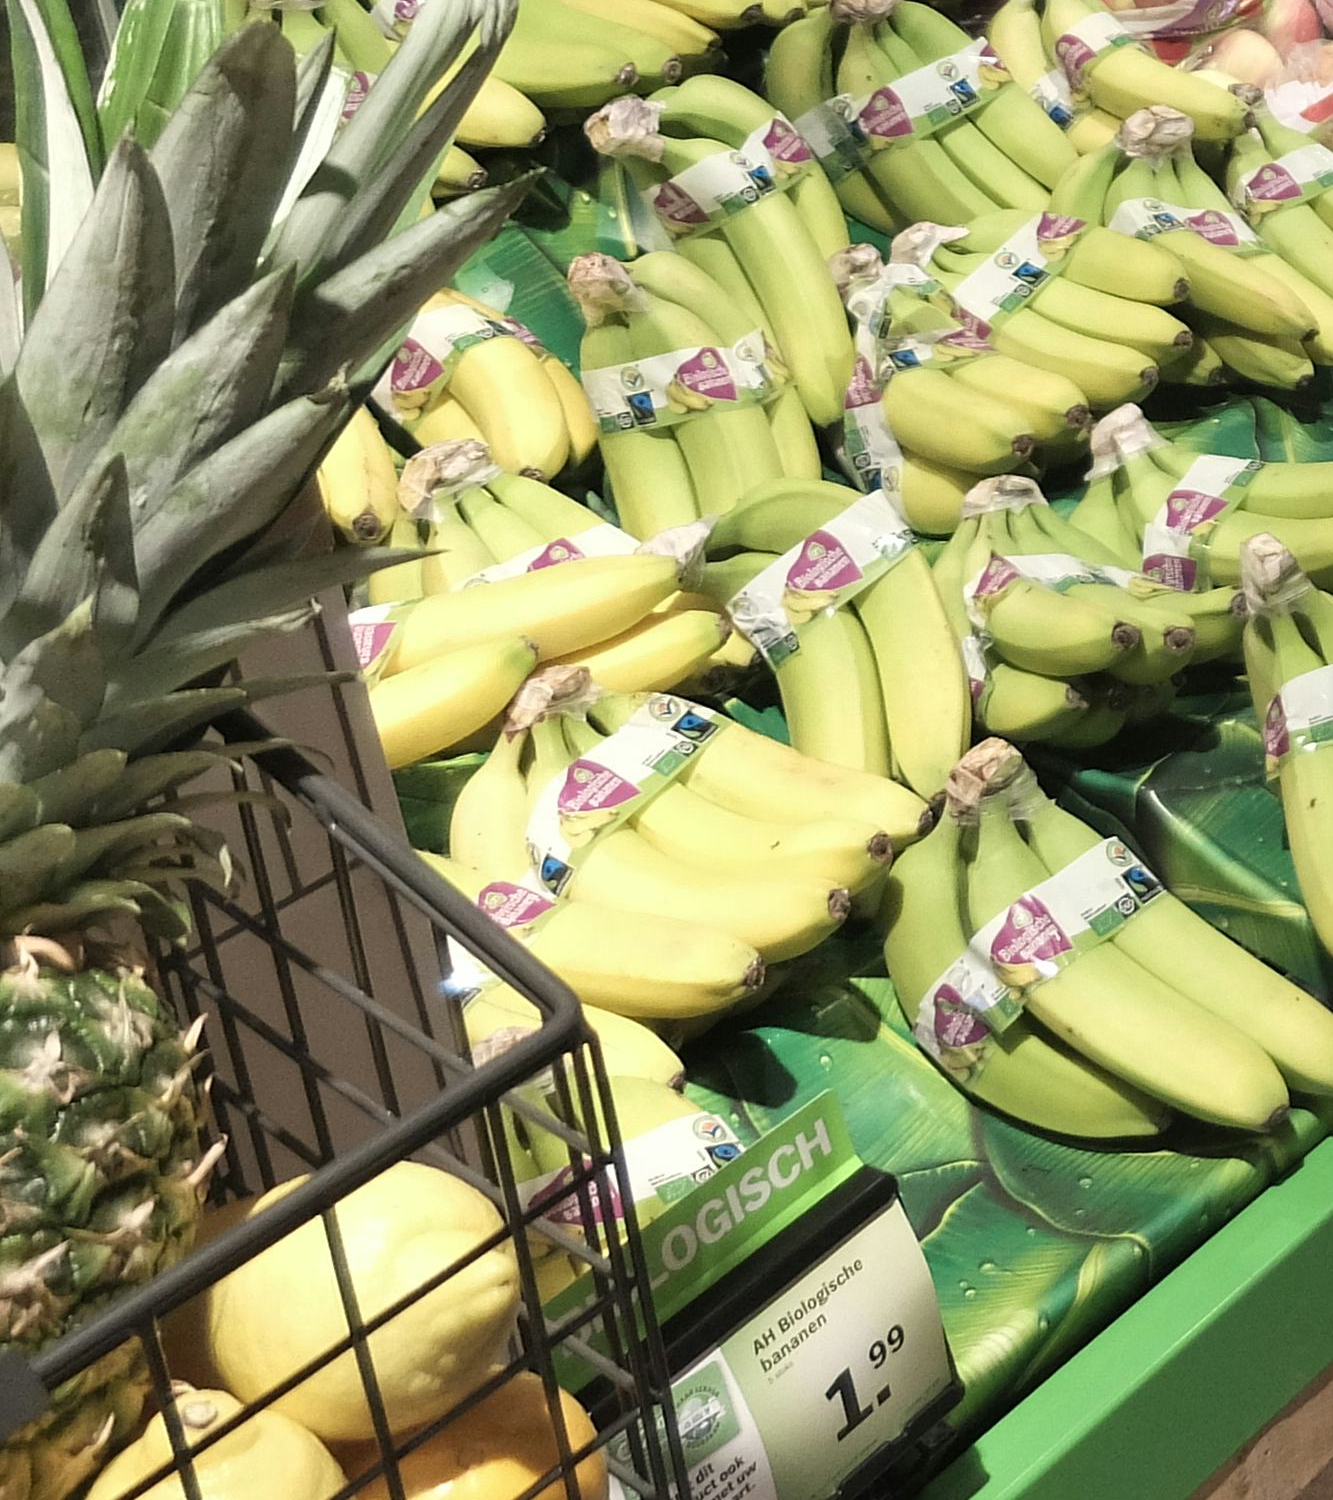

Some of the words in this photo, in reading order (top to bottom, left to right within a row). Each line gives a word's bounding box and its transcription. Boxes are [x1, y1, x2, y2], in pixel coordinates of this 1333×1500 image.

[751, 1331, 776, 1357] AH
[776, 1256, 864, 1336] Biologische
[759, 1311, 828, 1373] bananen
[695, 1462, 715, 1484] dit
[719, 1455, 745, 1482] ook
[736, 1460, 757, 1484] uw
